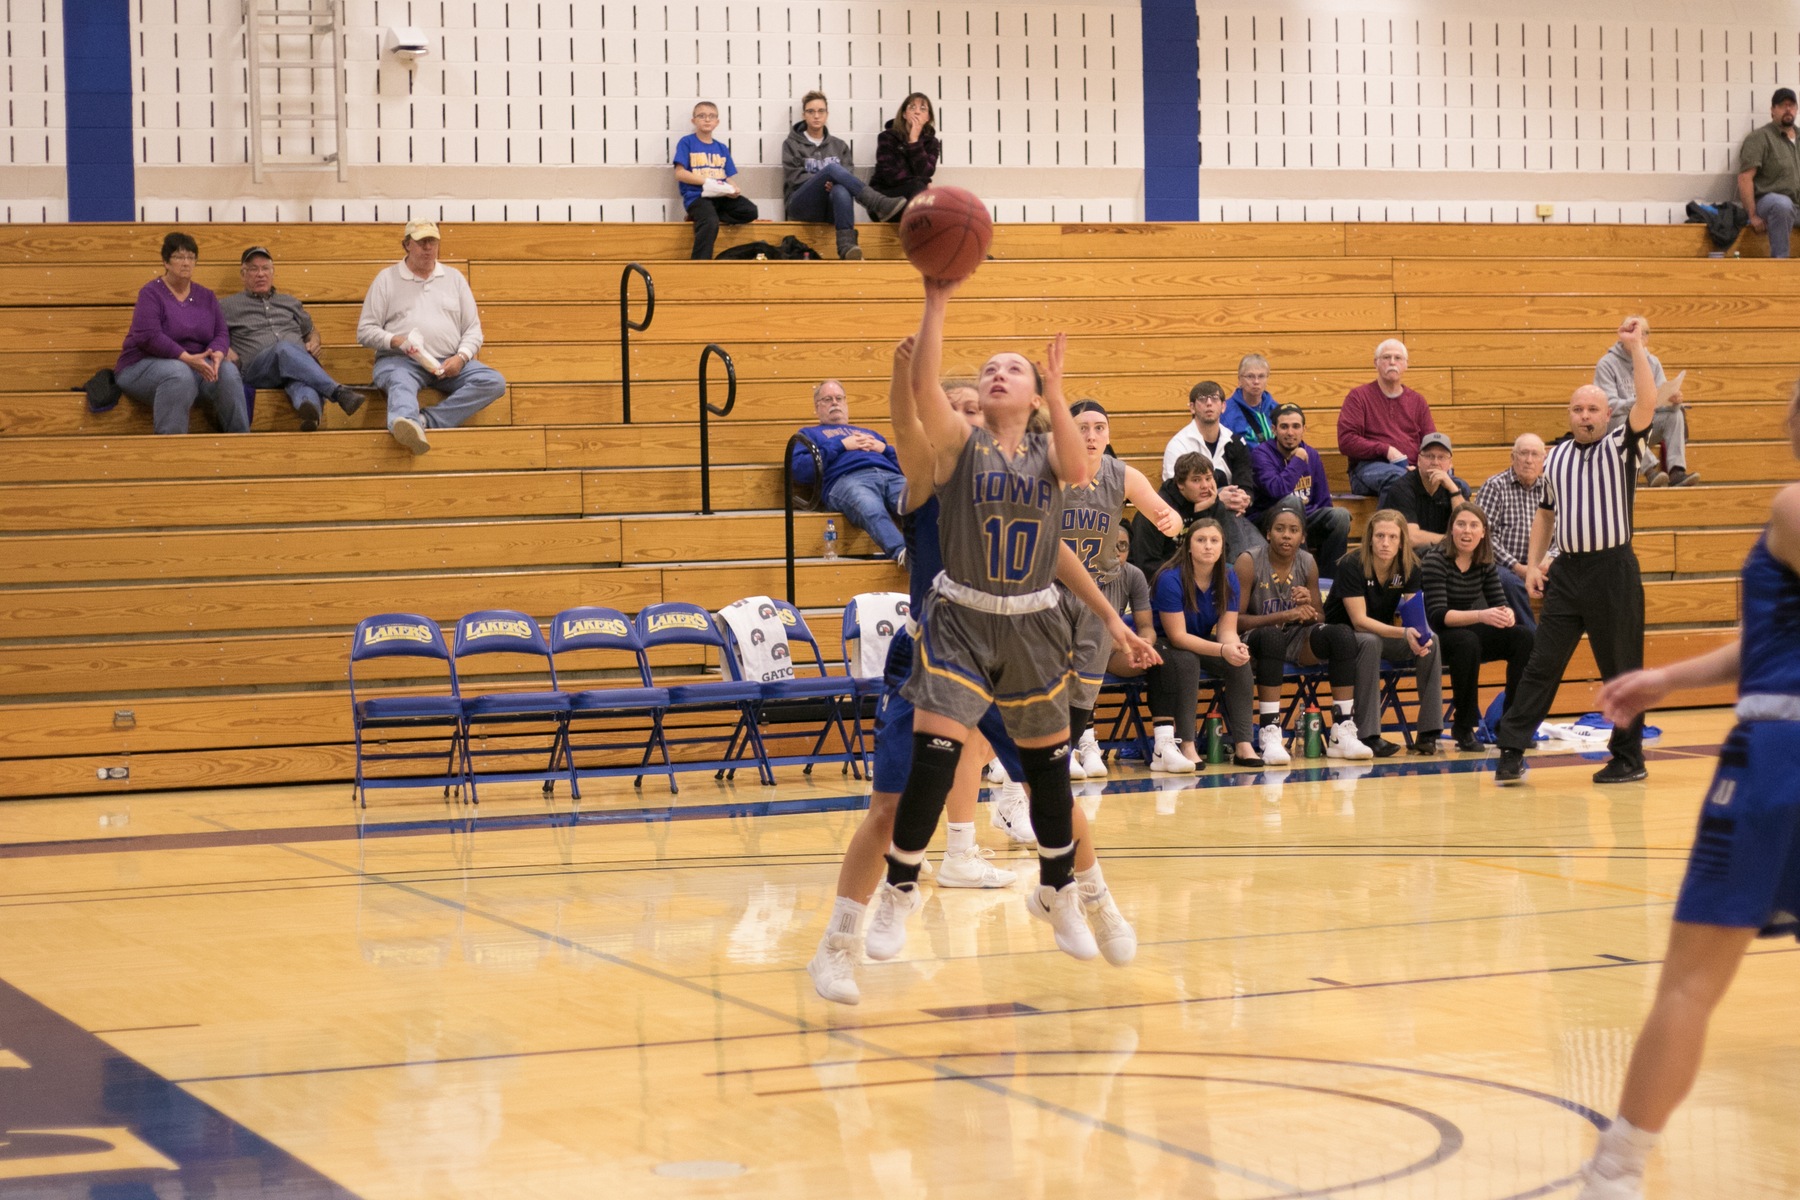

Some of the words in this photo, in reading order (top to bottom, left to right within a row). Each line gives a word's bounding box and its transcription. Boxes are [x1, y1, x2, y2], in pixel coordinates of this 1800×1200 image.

[973, 470, 1052, 516] IOWA
[1061, 508, 1111, 535] OWA
[983, 515, 1042, 584] 10
[466, 620, 533, 640] LAKERS
[563, 618, 628, 639] LAKERS
[647, 612, 709, 633] LAKERS
[364, 624, 433, 644] LAKERS
